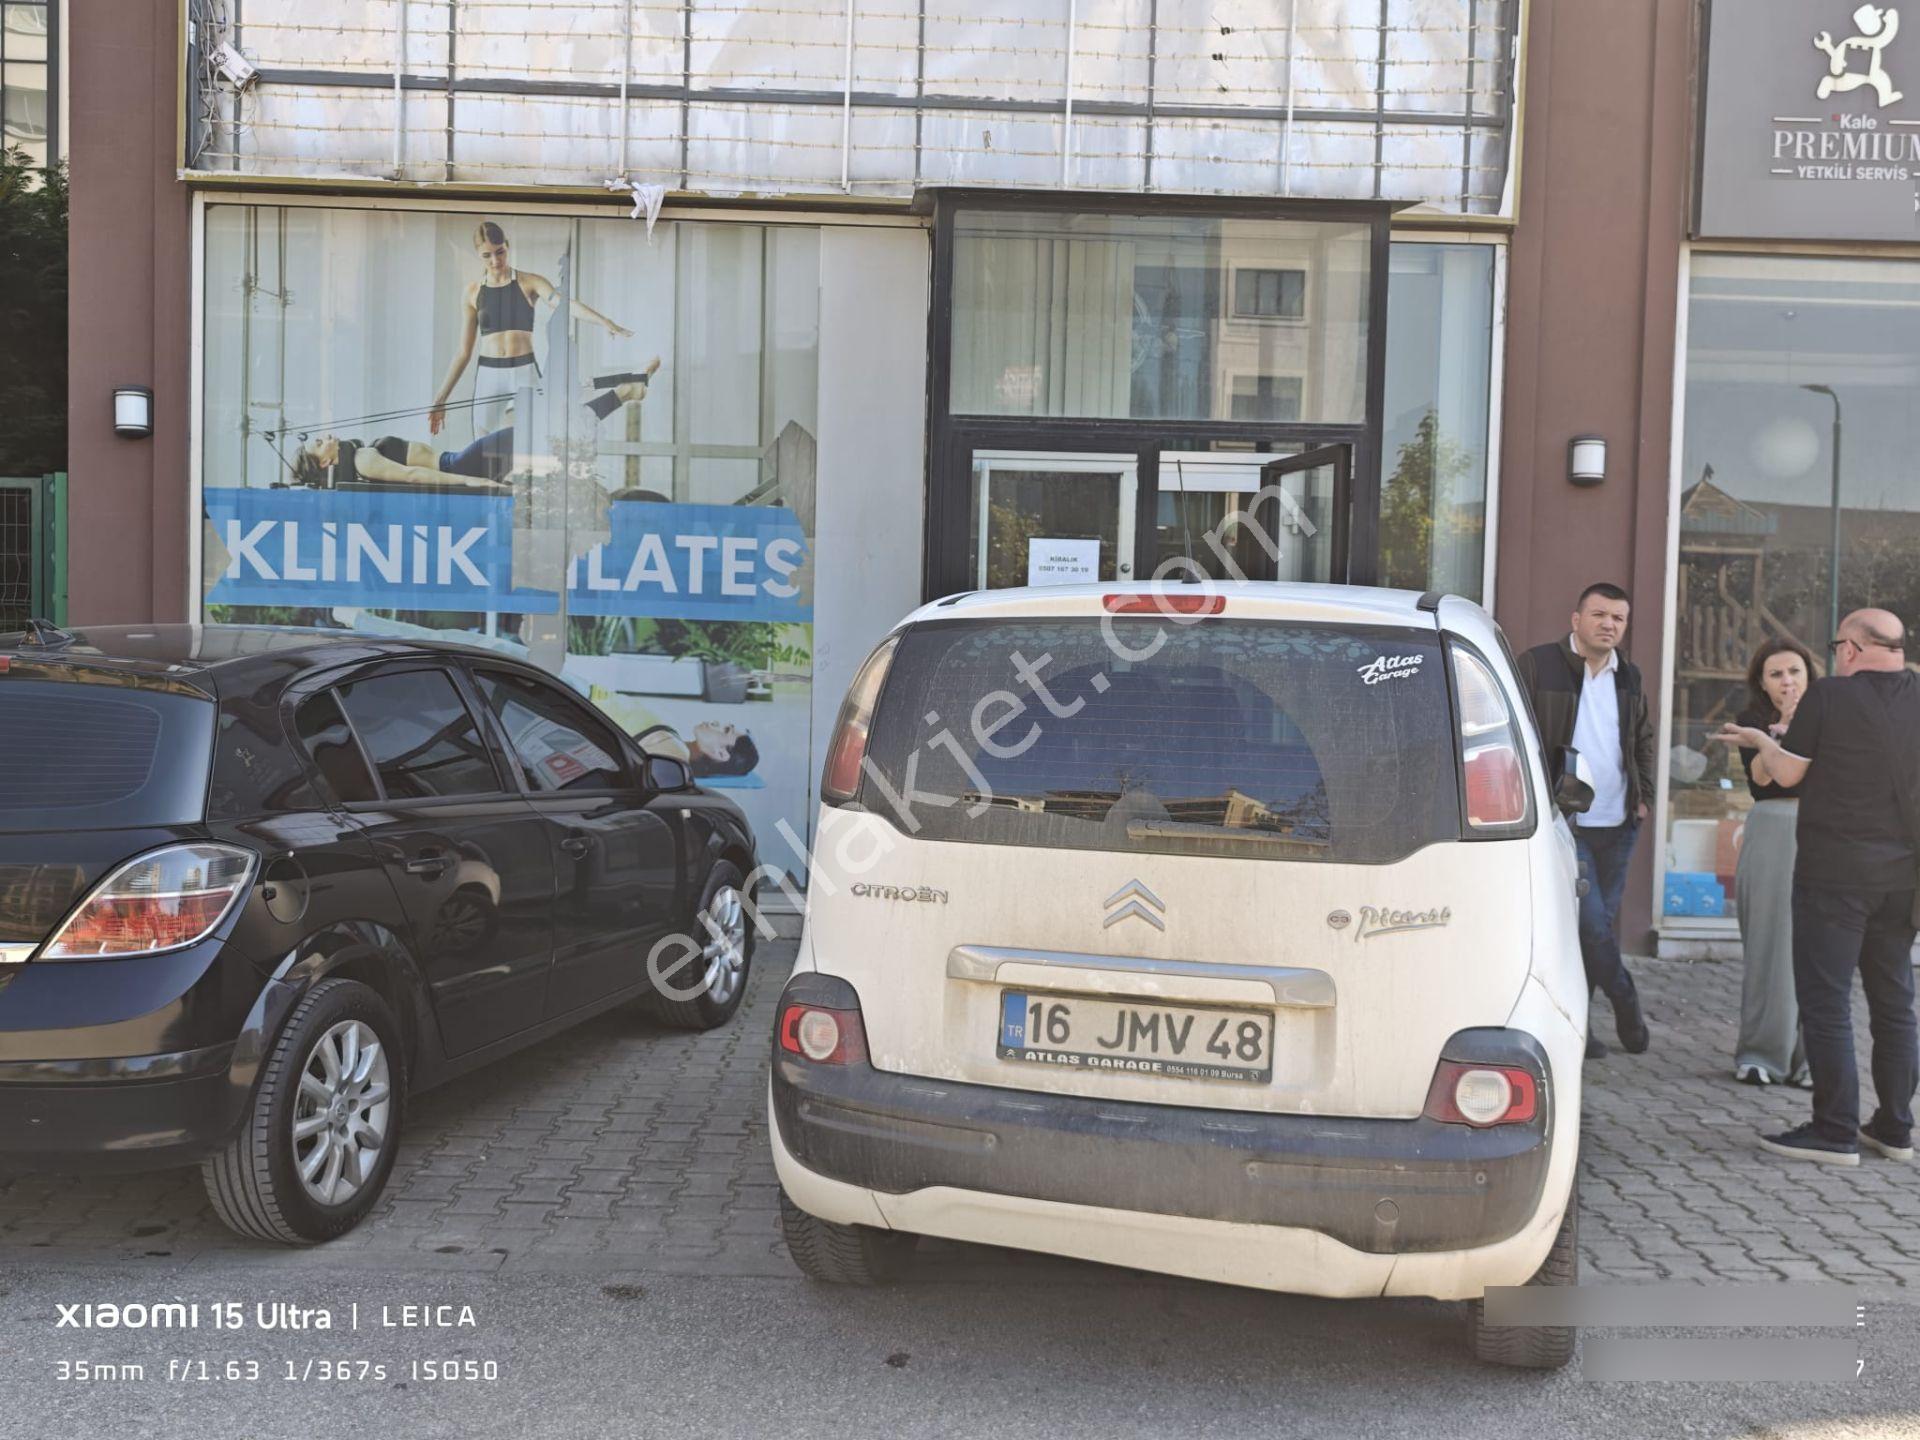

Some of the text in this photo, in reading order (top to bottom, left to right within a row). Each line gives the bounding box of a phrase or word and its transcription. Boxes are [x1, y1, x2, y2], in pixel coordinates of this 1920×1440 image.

[1840, 114, 1878, 130] Kale
[1798, 163, 1908, 181] YETKİLİ SERVİS
[566, 534, 801, 598] ILATES
[1363, 667, 1419, 685] Garage
[851, 882, 949, 904] CITROËN
[1008, 1023, 1024, 1039] TR
[1028, 1002, 1263, 1062] 16 JMV 48
[1025, 1050, 1080, 1065] ATLAS
[1088, 1055, 1163, 1072] GARAGE
[1221, 1070, 1244, 1080] Bursa
